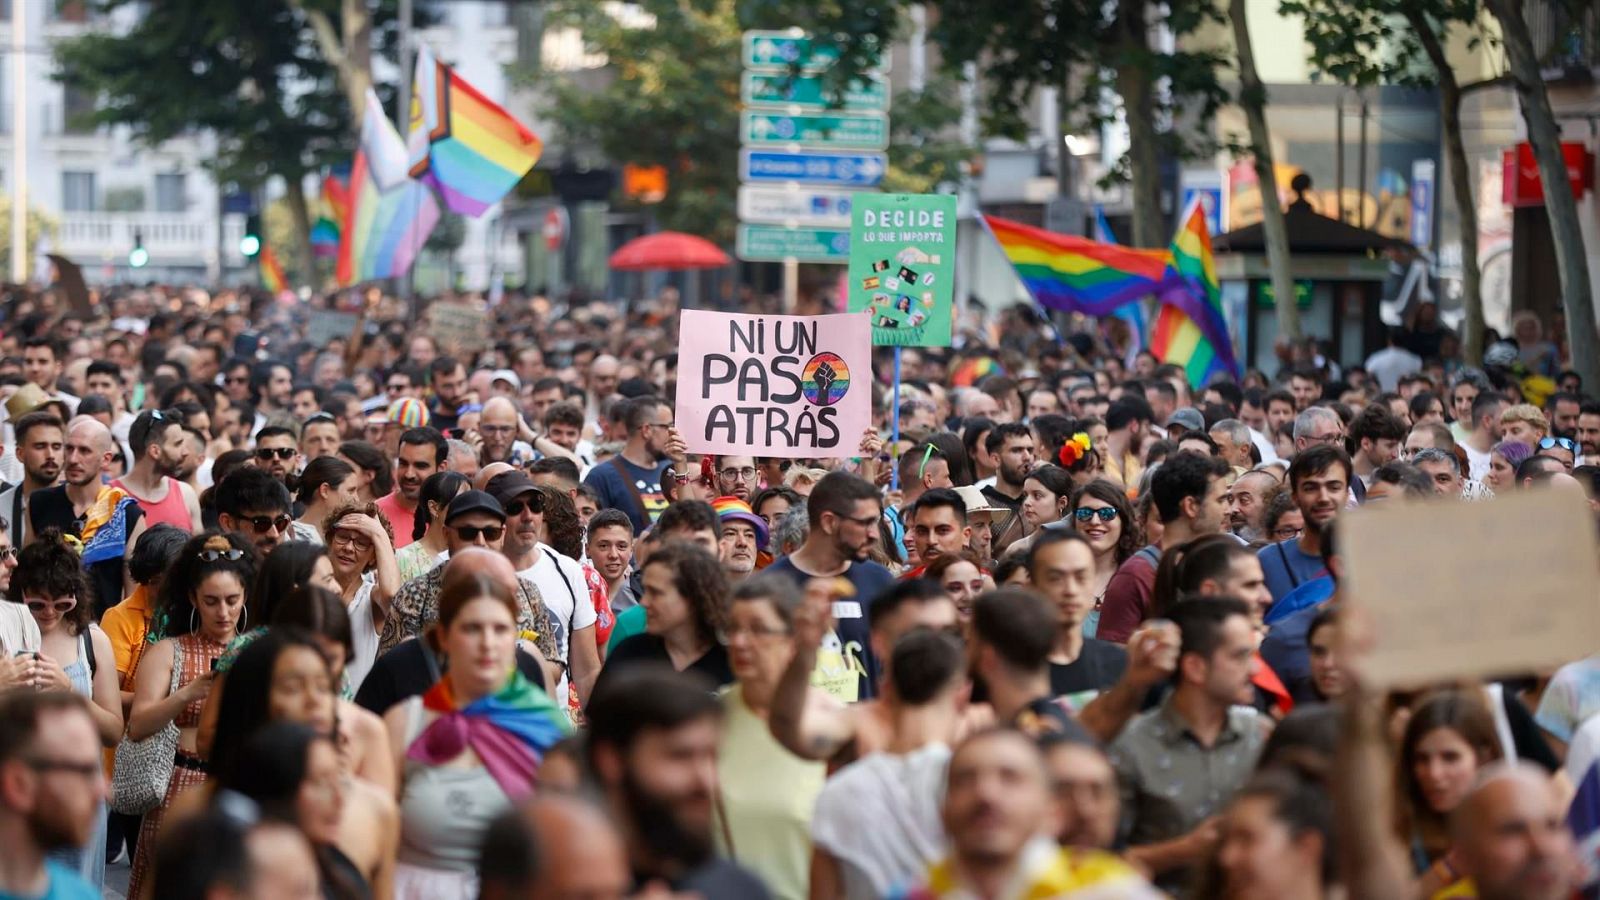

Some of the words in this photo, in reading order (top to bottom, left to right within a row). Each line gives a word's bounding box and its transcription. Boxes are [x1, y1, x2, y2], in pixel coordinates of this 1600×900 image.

[864, 209, 944, 228] DECIDE
[864, 231, 876, 242] LO
[878, 231, 896, 242] QUE
[899, 231, 944, 243] IMPORTA
[774, 320, 817, 355] UN
[702, 351, 850, 406] PASO
[705, 404, 840, 448] ATRÁS
